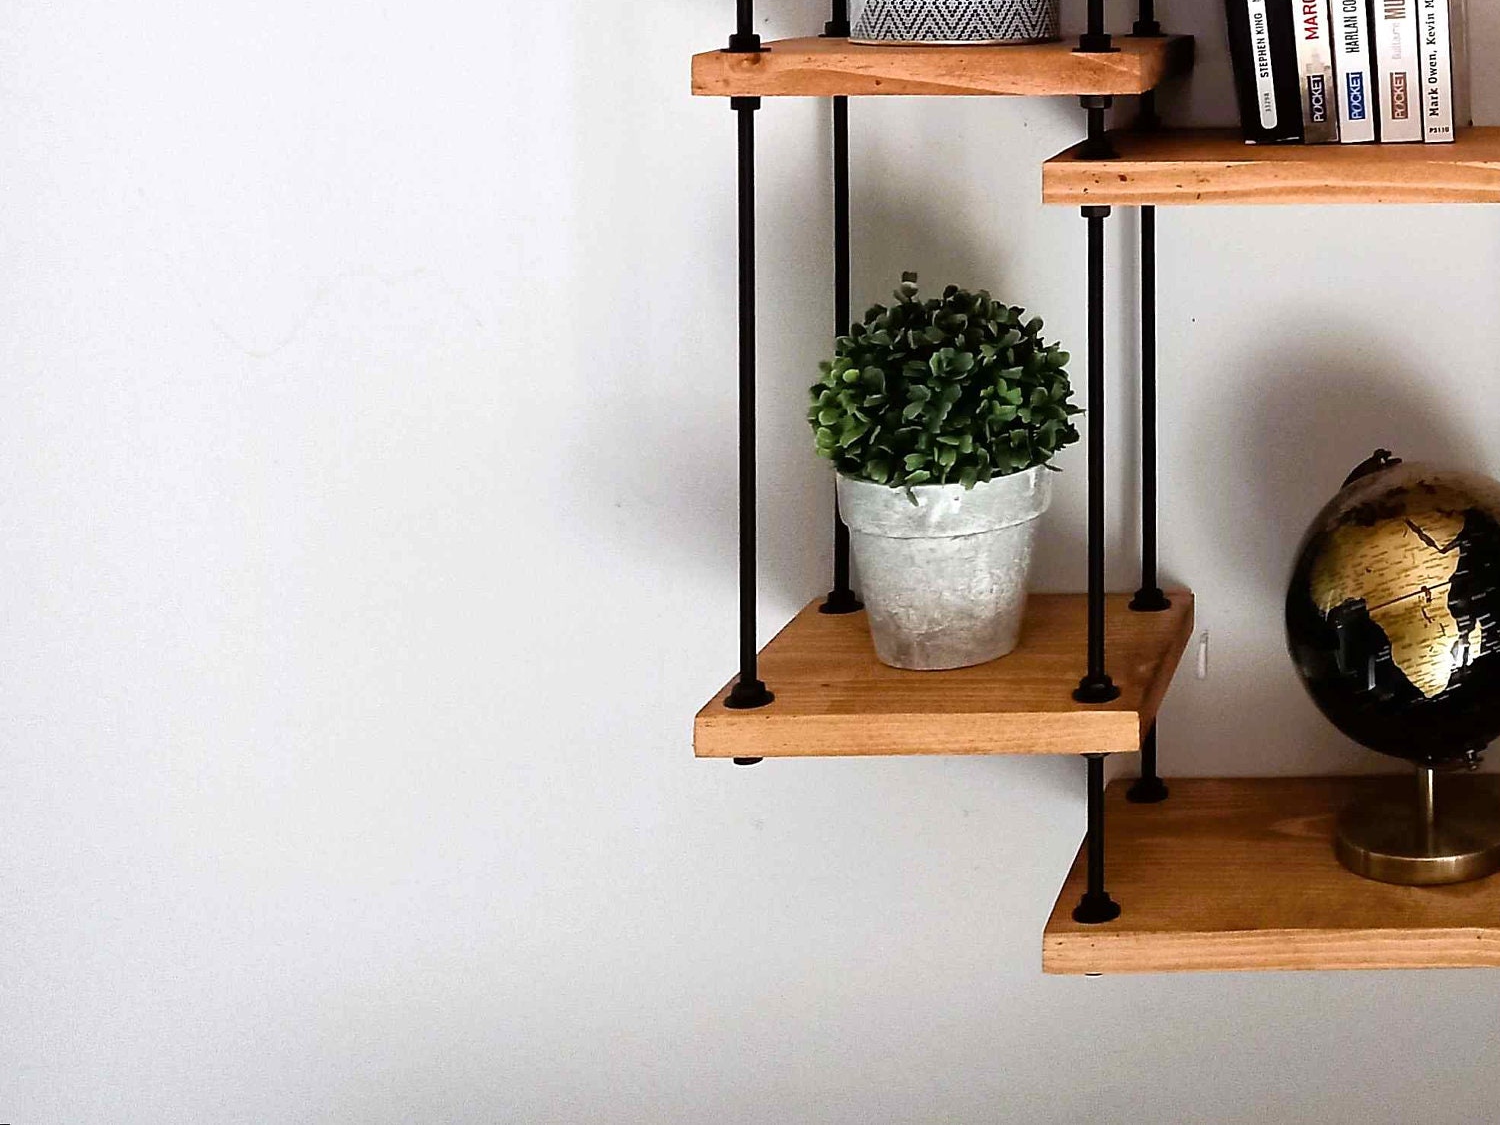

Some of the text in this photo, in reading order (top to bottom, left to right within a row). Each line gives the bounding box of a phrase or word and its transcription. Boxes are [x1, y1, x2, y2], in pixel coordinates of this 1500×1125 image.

[1253, 12, 1270, 79] STEPHEN KING
[1343, 15, 1360, 54] HARLAN
[1425, 12, 1436, 45] Kevin
[1427, 50, 1439, 84] Owen,
[1308, 75, 1325, 123] POCKET
[1348, 72, 1365, 120] POCKET
[1392, 72, 1408, 119] POCKET
[1429, 87, 1440, 117] Mark
